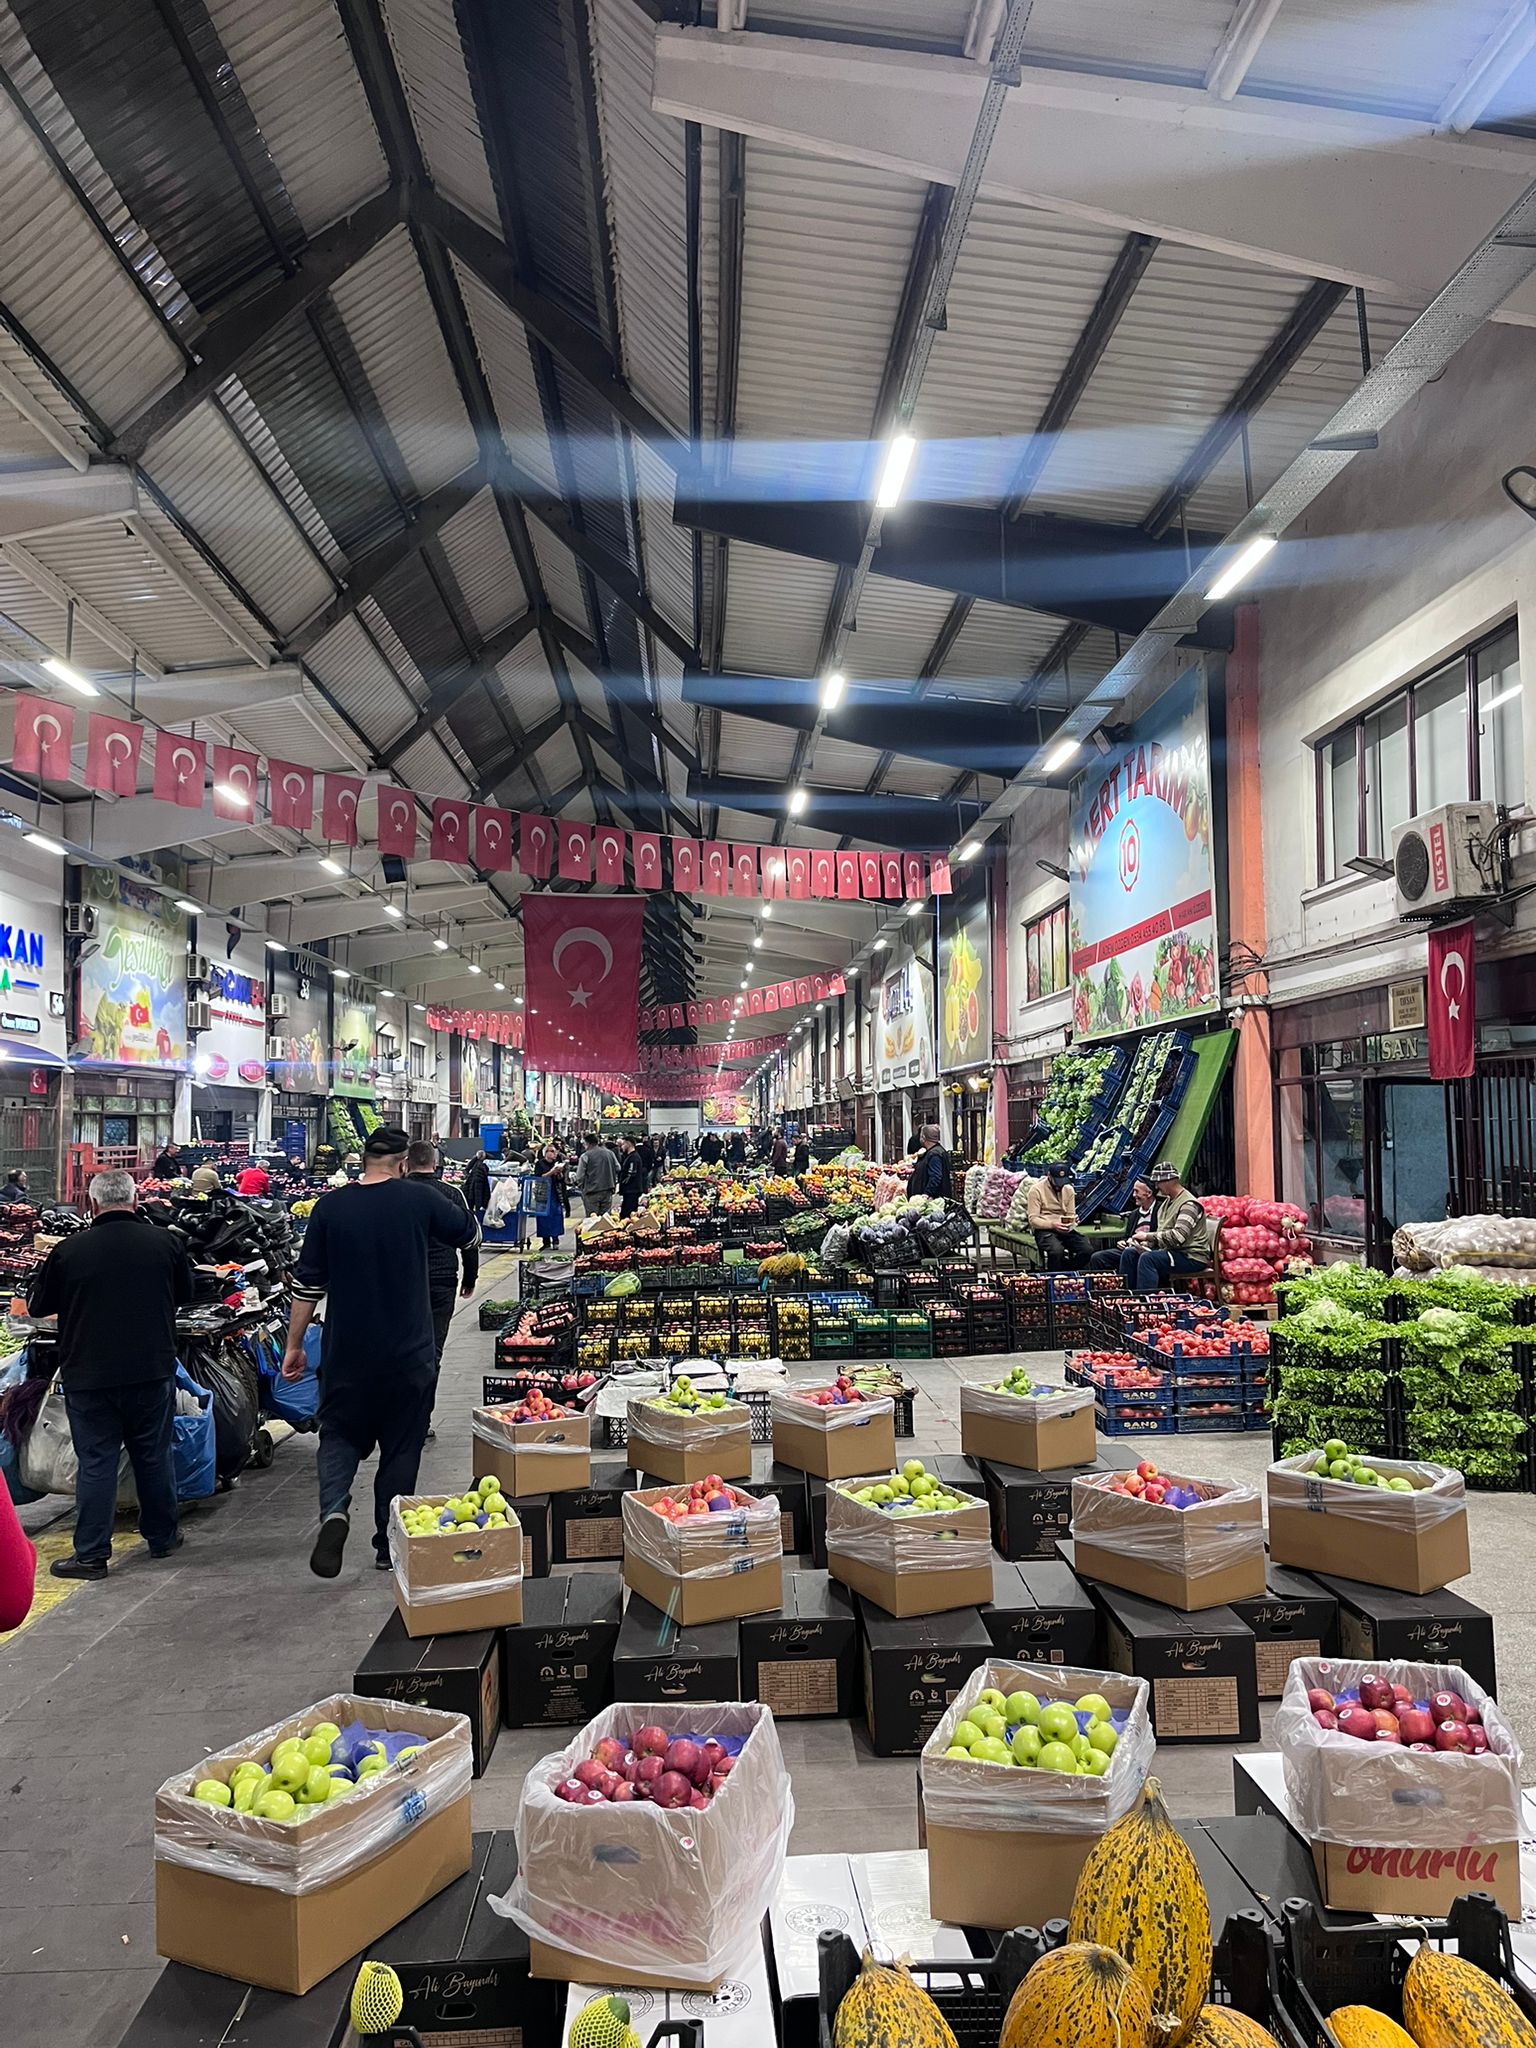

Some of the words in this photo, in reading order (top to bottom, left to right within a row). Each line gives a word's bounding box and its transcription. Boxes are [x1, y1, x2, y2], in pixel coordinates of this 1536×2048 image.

[1123, 742, 1190, 821] TARIM
[1121, 835, 1137, 877] 10
[1433, 829, 1446, 889] VESTEL
[51, 993, 65, 1016] 56
[1381, 1037, 1418, 1060] SAN
[1346, 1830, 1499, 1884] onurlu
[408, 1974, 440, 2000] Ali
